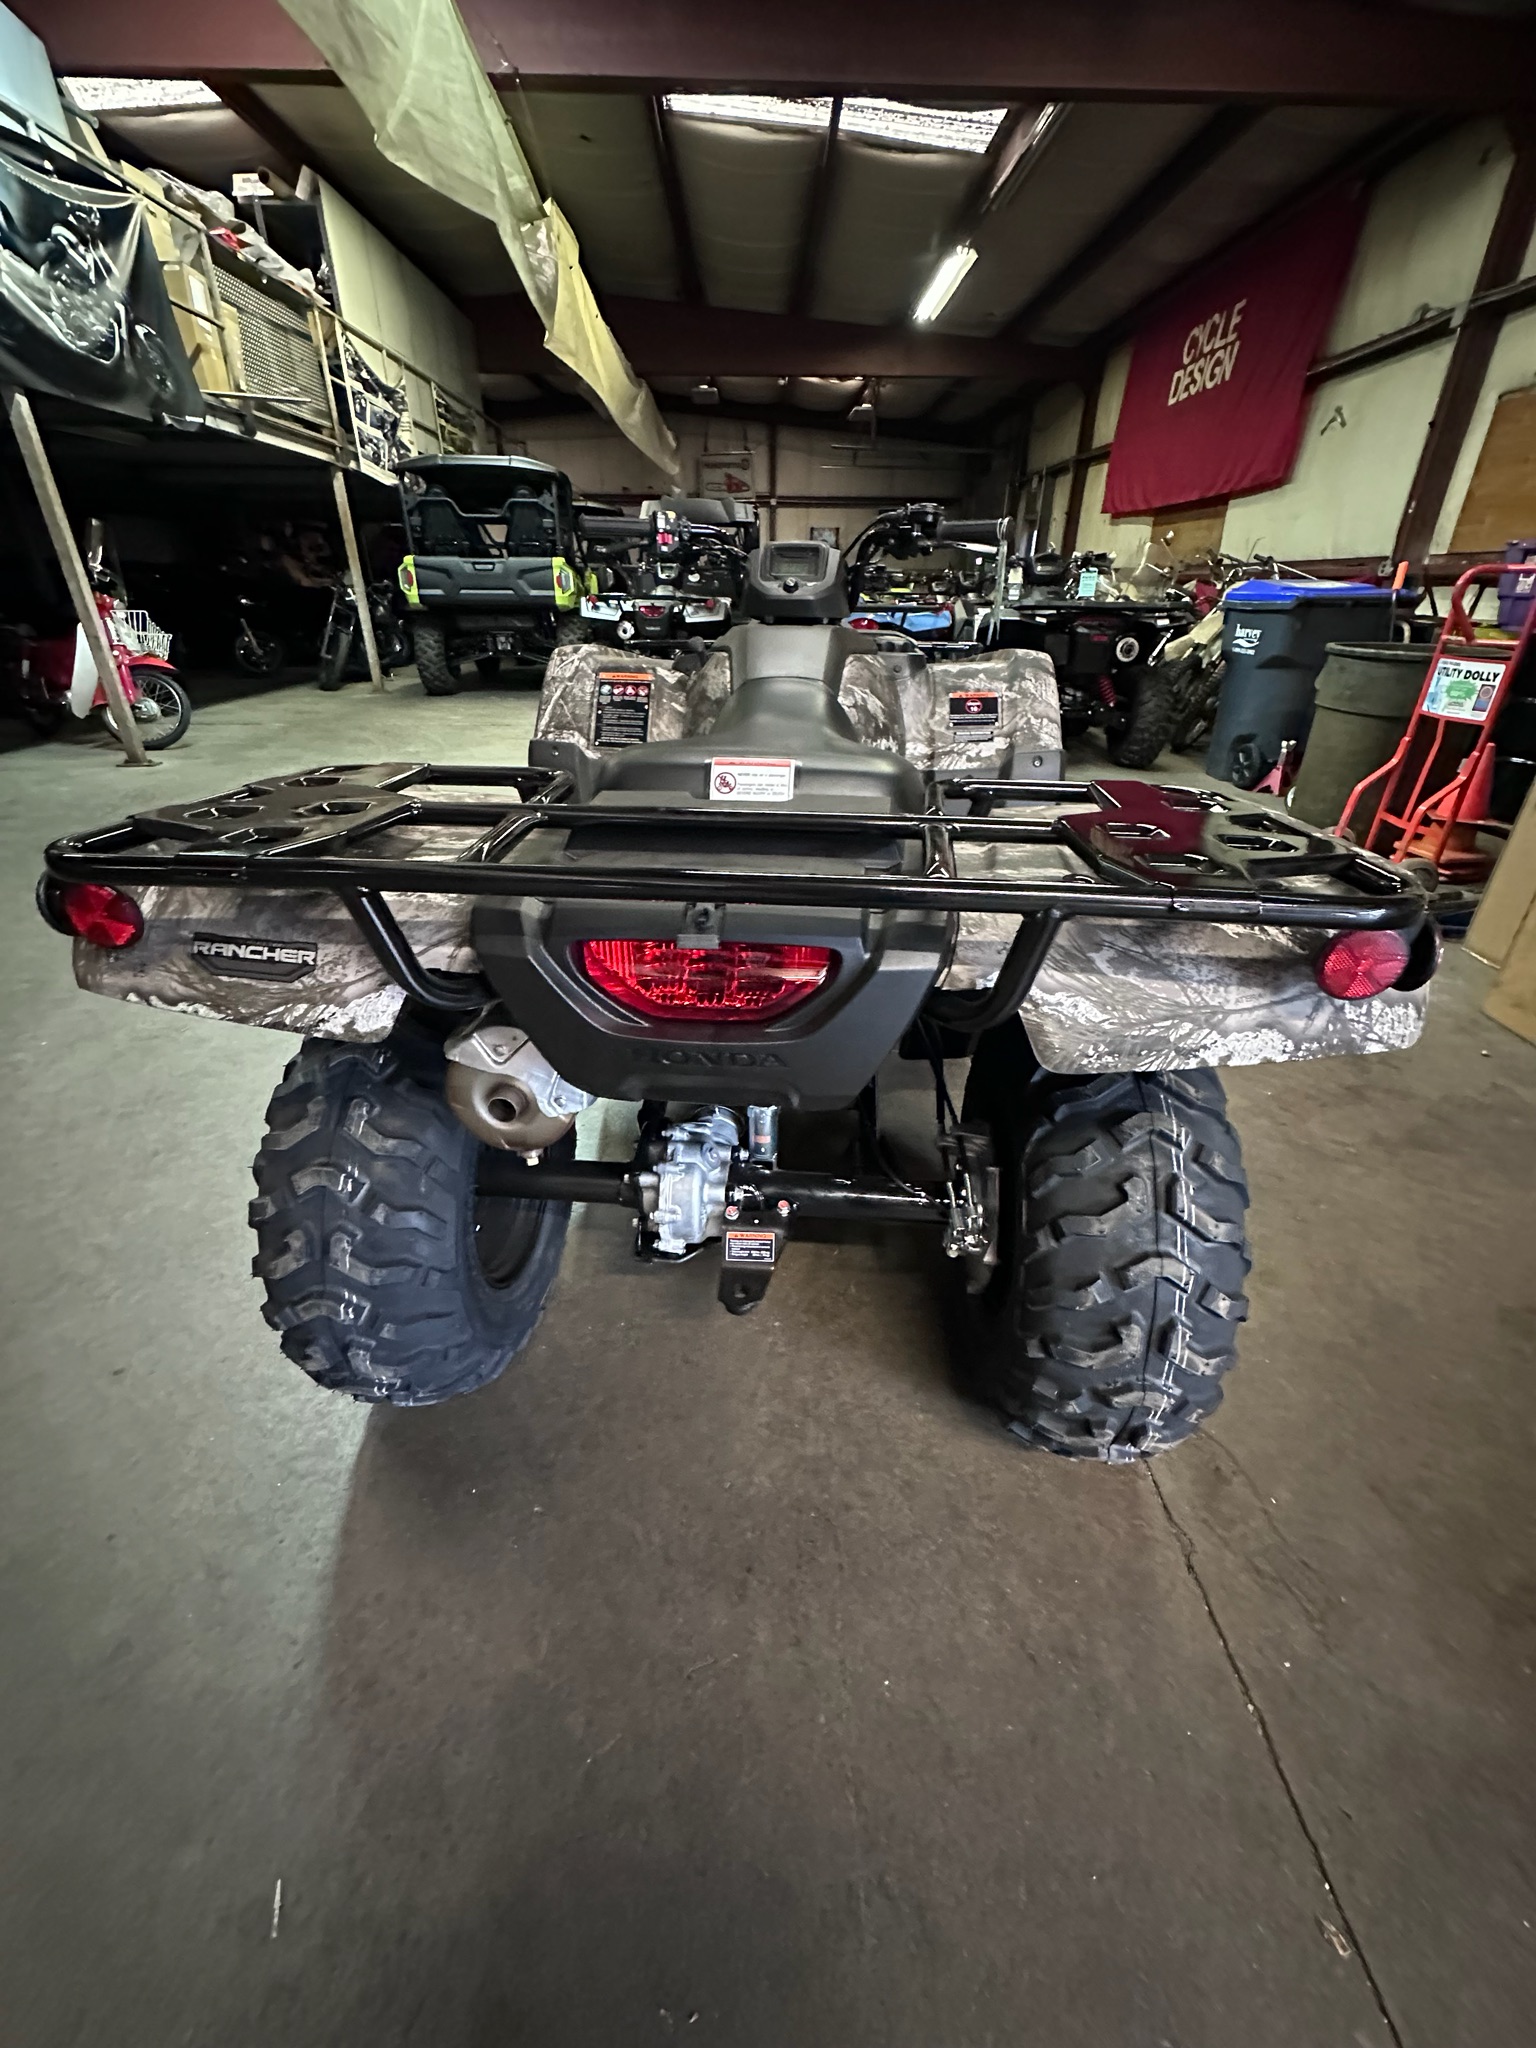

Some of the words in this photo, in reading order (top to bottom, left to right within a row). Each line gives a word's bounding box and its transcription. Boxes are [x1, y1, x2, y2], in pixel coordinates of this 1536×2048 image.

[1182, 298, 1247, 365] CYCLE
[1167, 340, 1240, 406] DESIGN
[1437, 666, 1463, 679] UTILITY
[1463, 669, 1501, 683] DOLLY
[193, 941, 316, 965] RANCHER
